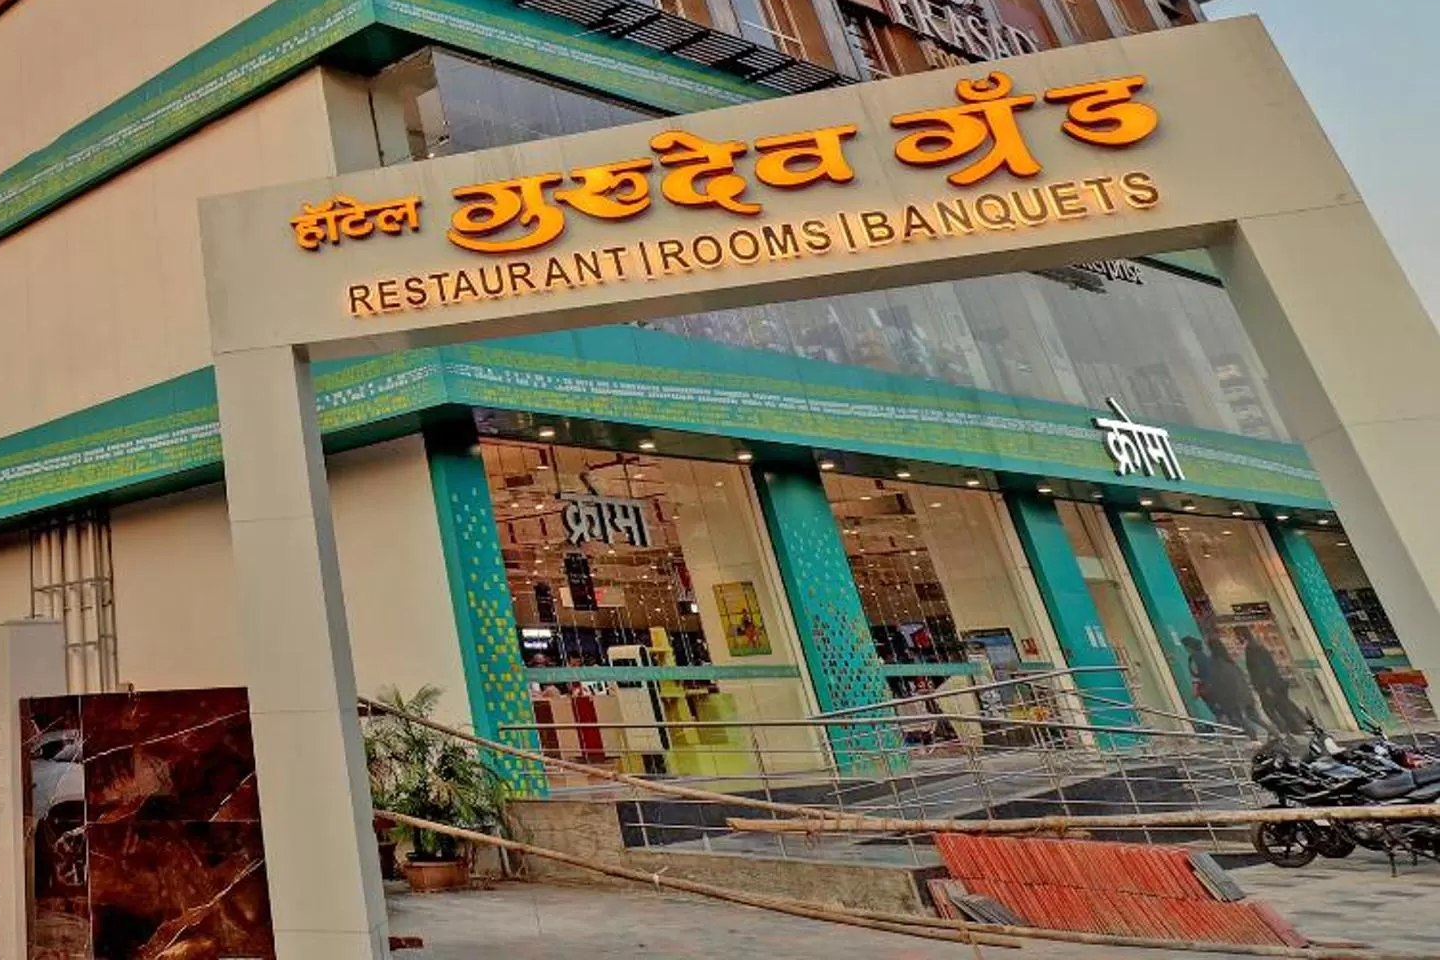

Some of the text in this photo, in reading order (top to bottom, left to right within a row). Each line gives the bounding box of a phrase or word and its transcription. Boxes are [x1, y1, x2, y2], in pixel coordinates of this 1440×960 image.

[291, 194, 422, 251] हॉटेल
[446, 123, 858, 255] गुरुदेव
[349, 247, 627, 314] RESTAURANT
[659, 219, 831, 272] ROOMS
[861, 171, 1160, 244] BANQUETS
[1093, 396, 1185, 481] क्रोमा
